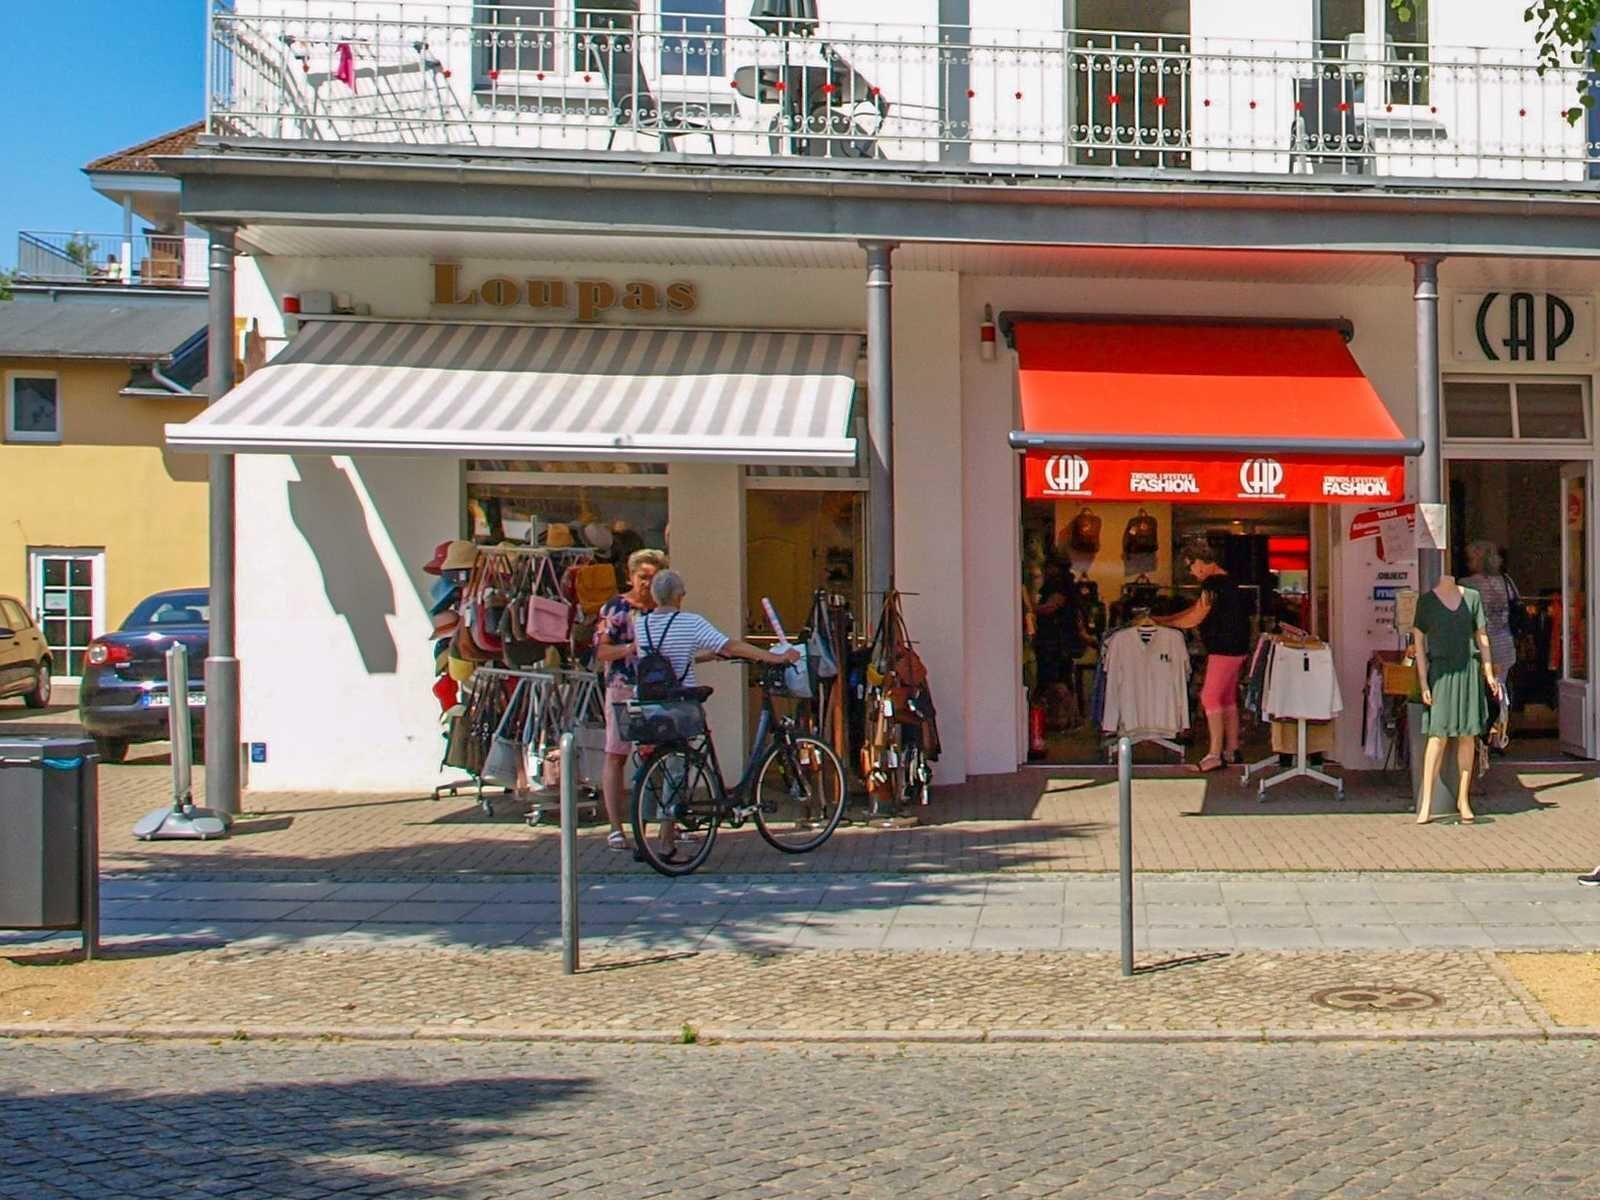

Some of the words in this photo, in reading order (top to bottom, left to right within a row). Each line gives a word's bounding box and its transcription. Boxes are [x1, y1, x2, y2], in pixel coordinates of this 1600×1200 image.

[430, 263, 697, 322] Loupas
[1476, 292, 1574, 360] CAP
[1044, 455, 1090, 491] CAP
[1239, 458, 1284, 494] CAP
